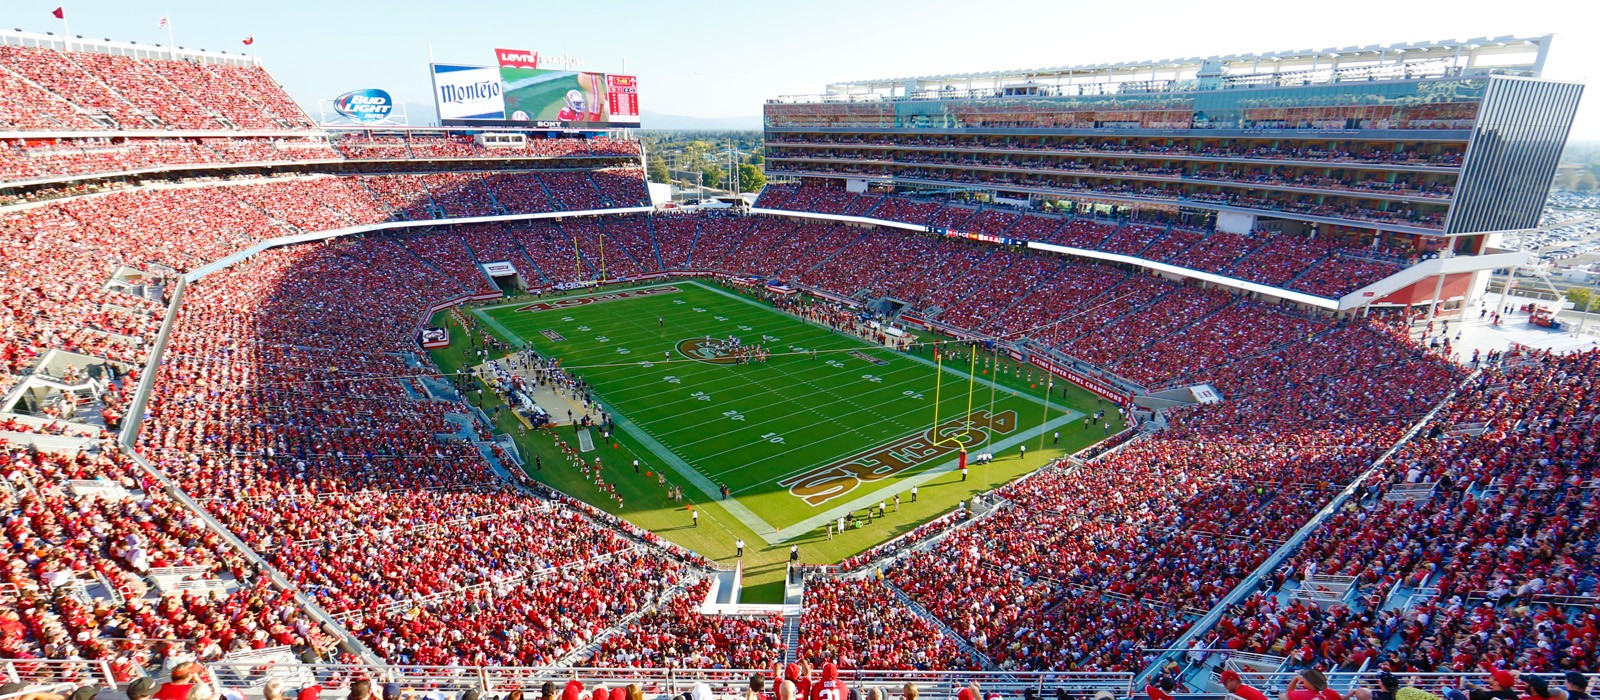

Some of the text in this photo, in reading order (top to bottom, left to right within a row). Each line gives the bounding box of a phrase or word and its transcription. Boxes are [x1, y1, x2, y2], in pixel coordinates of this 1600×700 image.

[540, 55, 585, 67] STADIUM
[440, 80, 500, 104] Montejo
[350, 95, 386, 105] BUD
[343, 103, 391, 113] LIGHT
[1049, 364, 1067, 377] SUPER
[1067, 373, 1084, 386] BOWL
[1084, 381, 1122, 403] CHAMPIONS
[722, 409, 744, 421] 20
[761, 432, 784, 444] 10
[777, 409, 1018, 507] 49ERS
